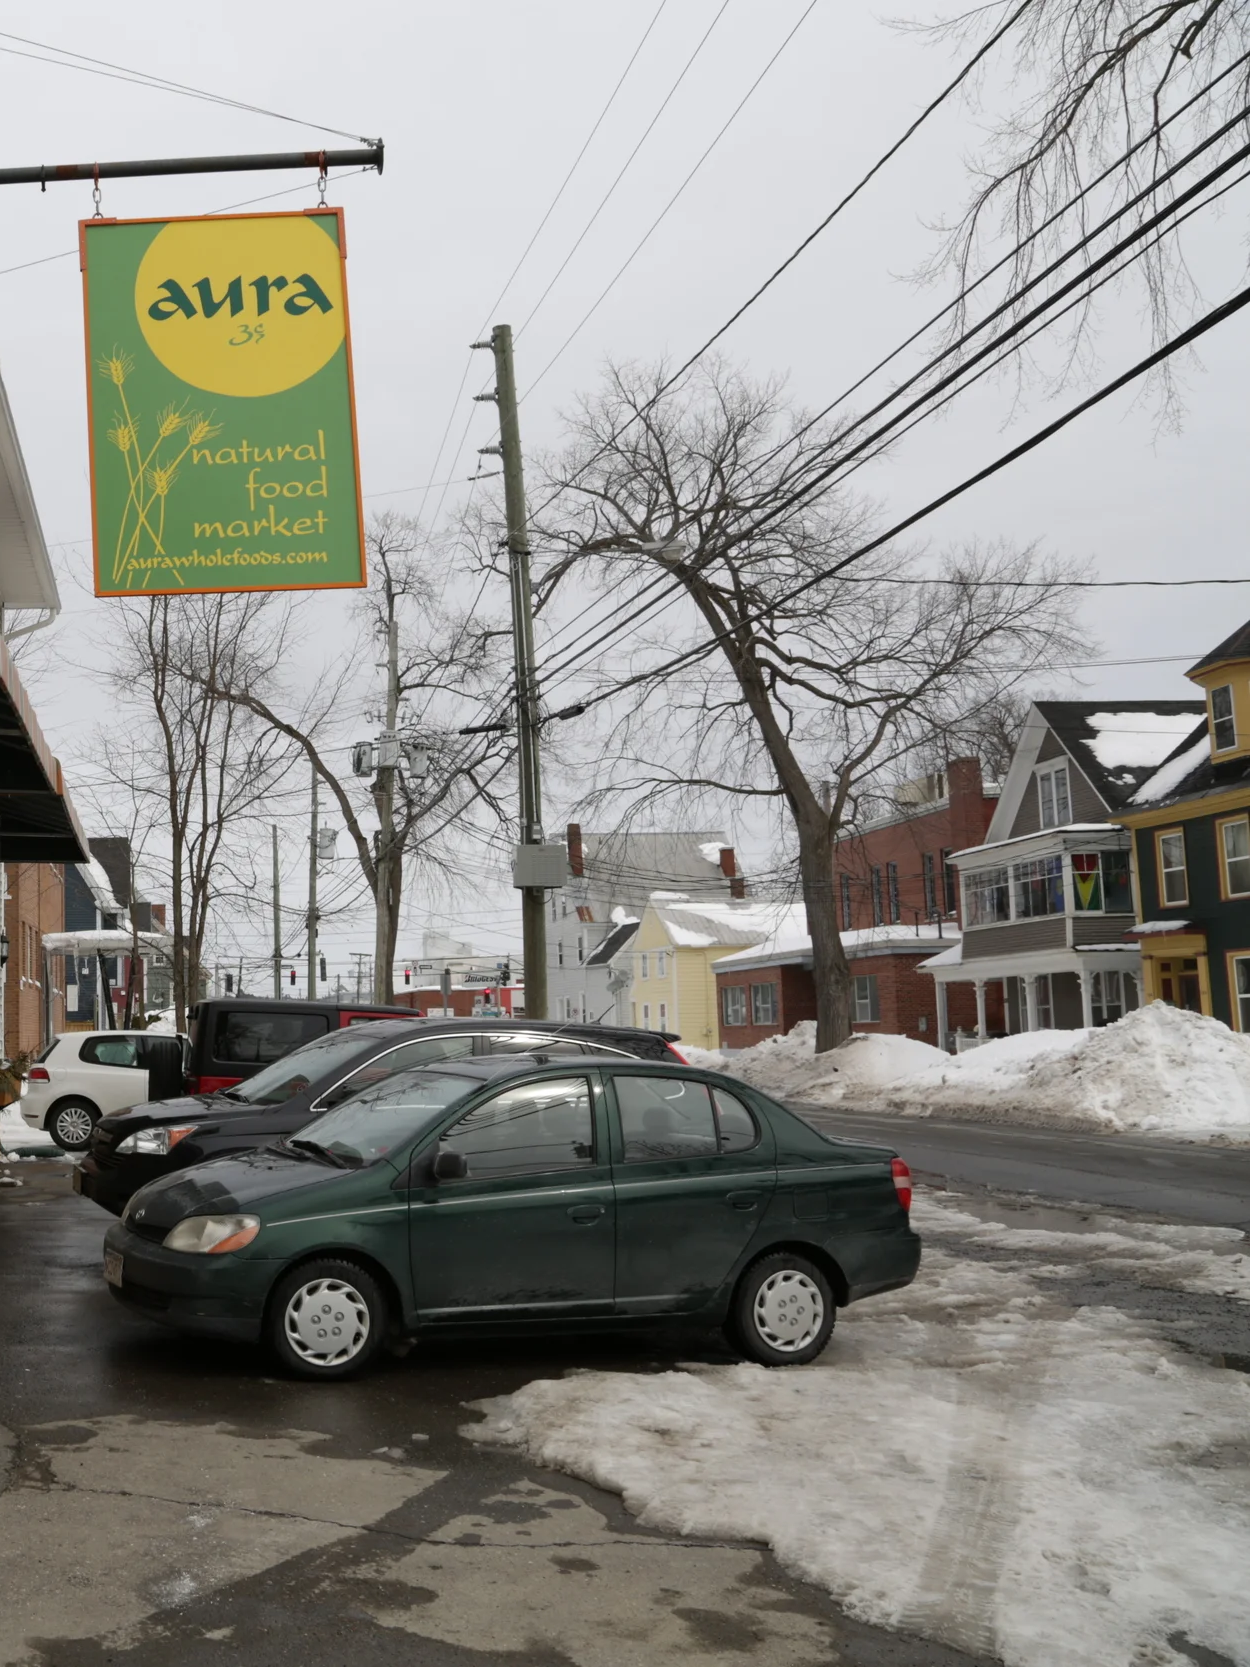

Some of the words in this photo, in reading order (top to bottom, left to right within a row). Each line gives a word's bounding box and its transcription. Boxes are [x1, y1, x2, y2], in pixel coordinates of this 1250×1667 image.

[147, 272, 334, 322] aura
[191, 430, 326, 466] natural
[244, 466, 328, 512] food
[193, 505, 329, 538] market
[125, 548, 328, 571] aurawholefoods.com
